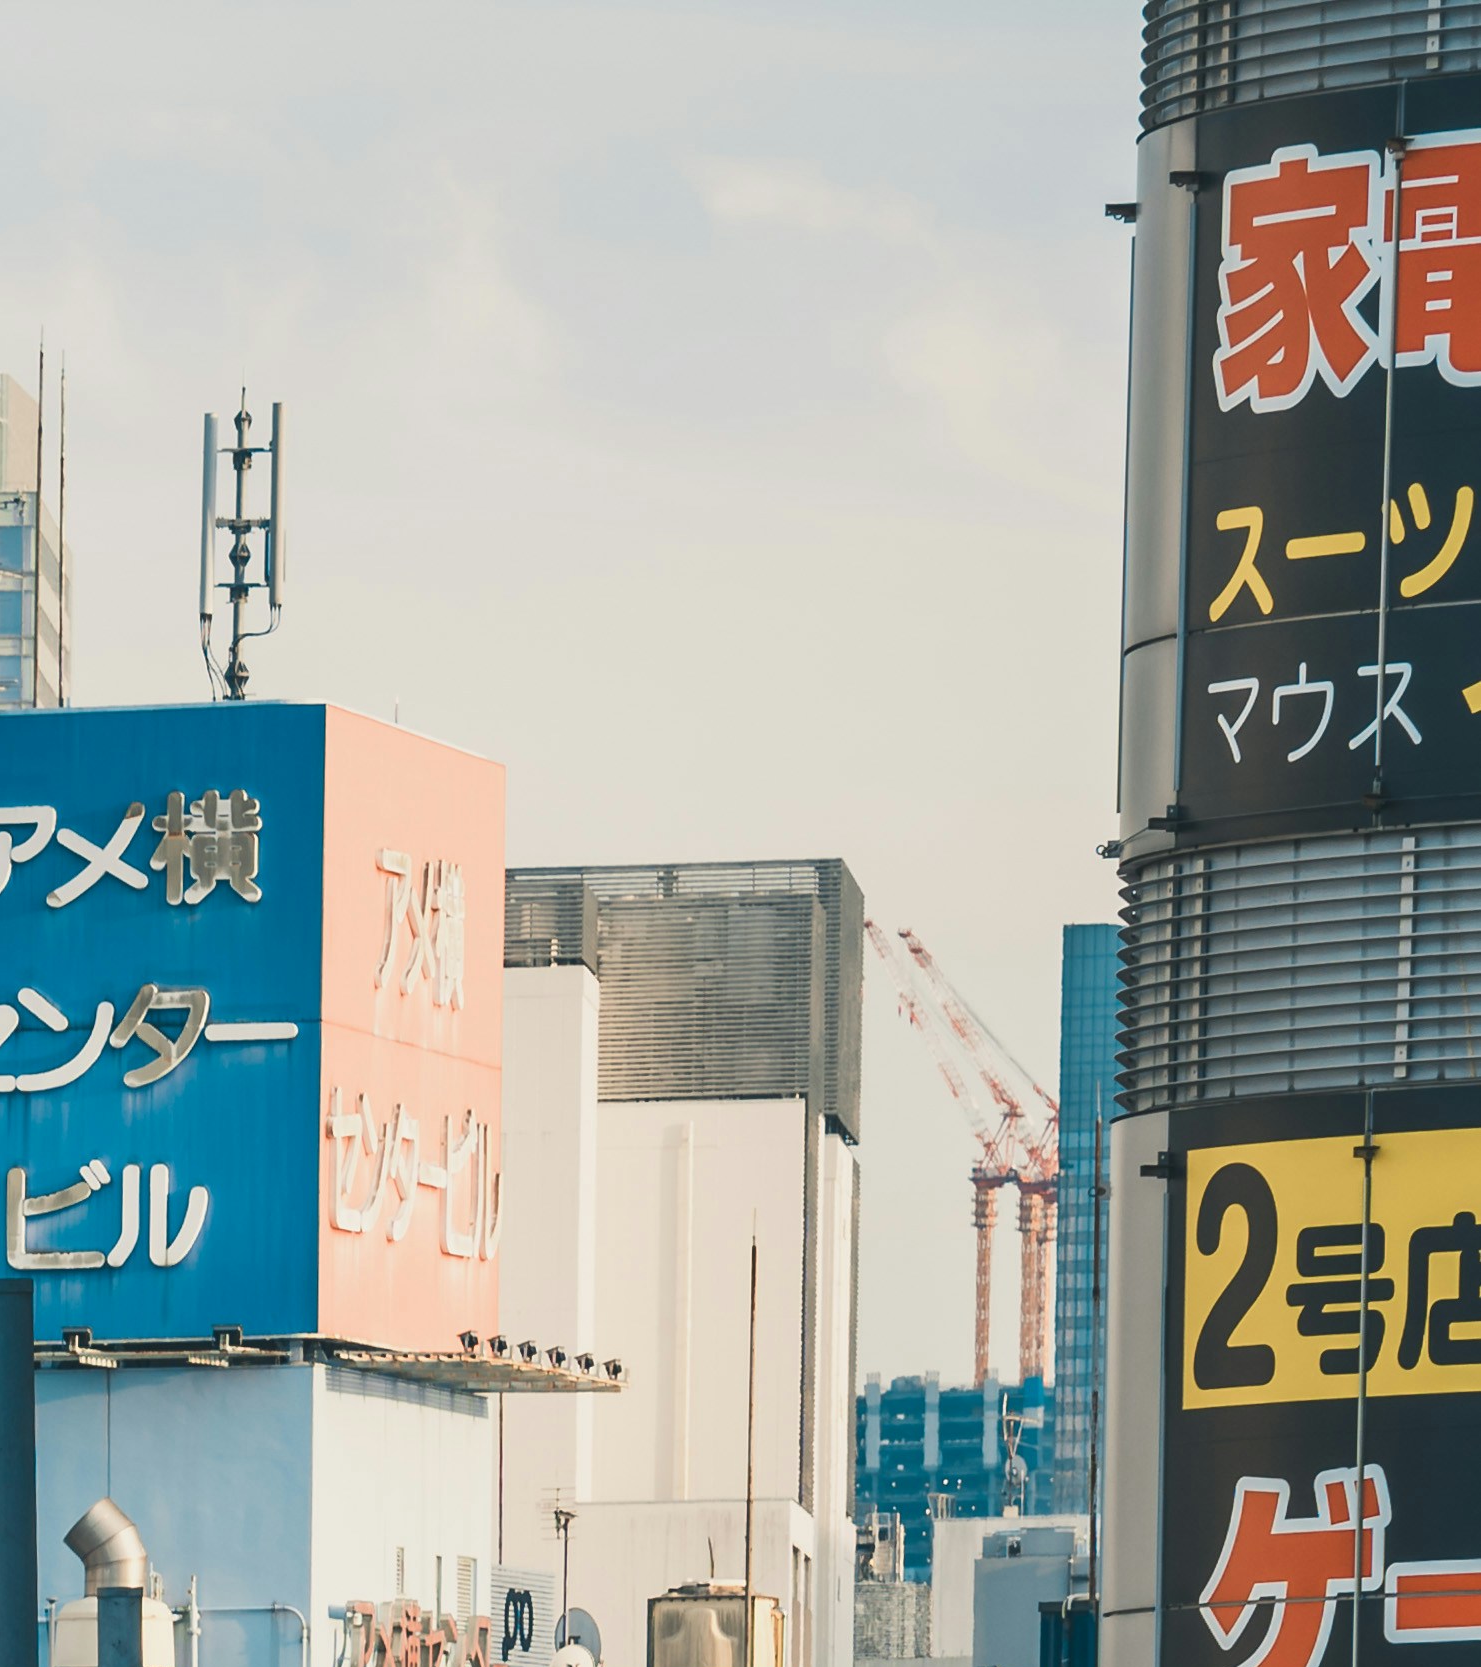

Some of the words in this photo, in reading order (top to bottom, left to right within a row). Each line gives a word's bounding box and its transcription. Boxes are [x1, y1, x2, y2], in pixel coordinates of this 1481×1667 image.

[1209, 482, 1474, 622] スーツ
[1208, 662, 1423, 764] マウス
[374, 846, 468, 1011] アメ横
[6, 1158, 209, 1270] ビル
[327, 1085, 503, 1262] センタービル
[1193, 1162, 1481, 1391] 2号店
